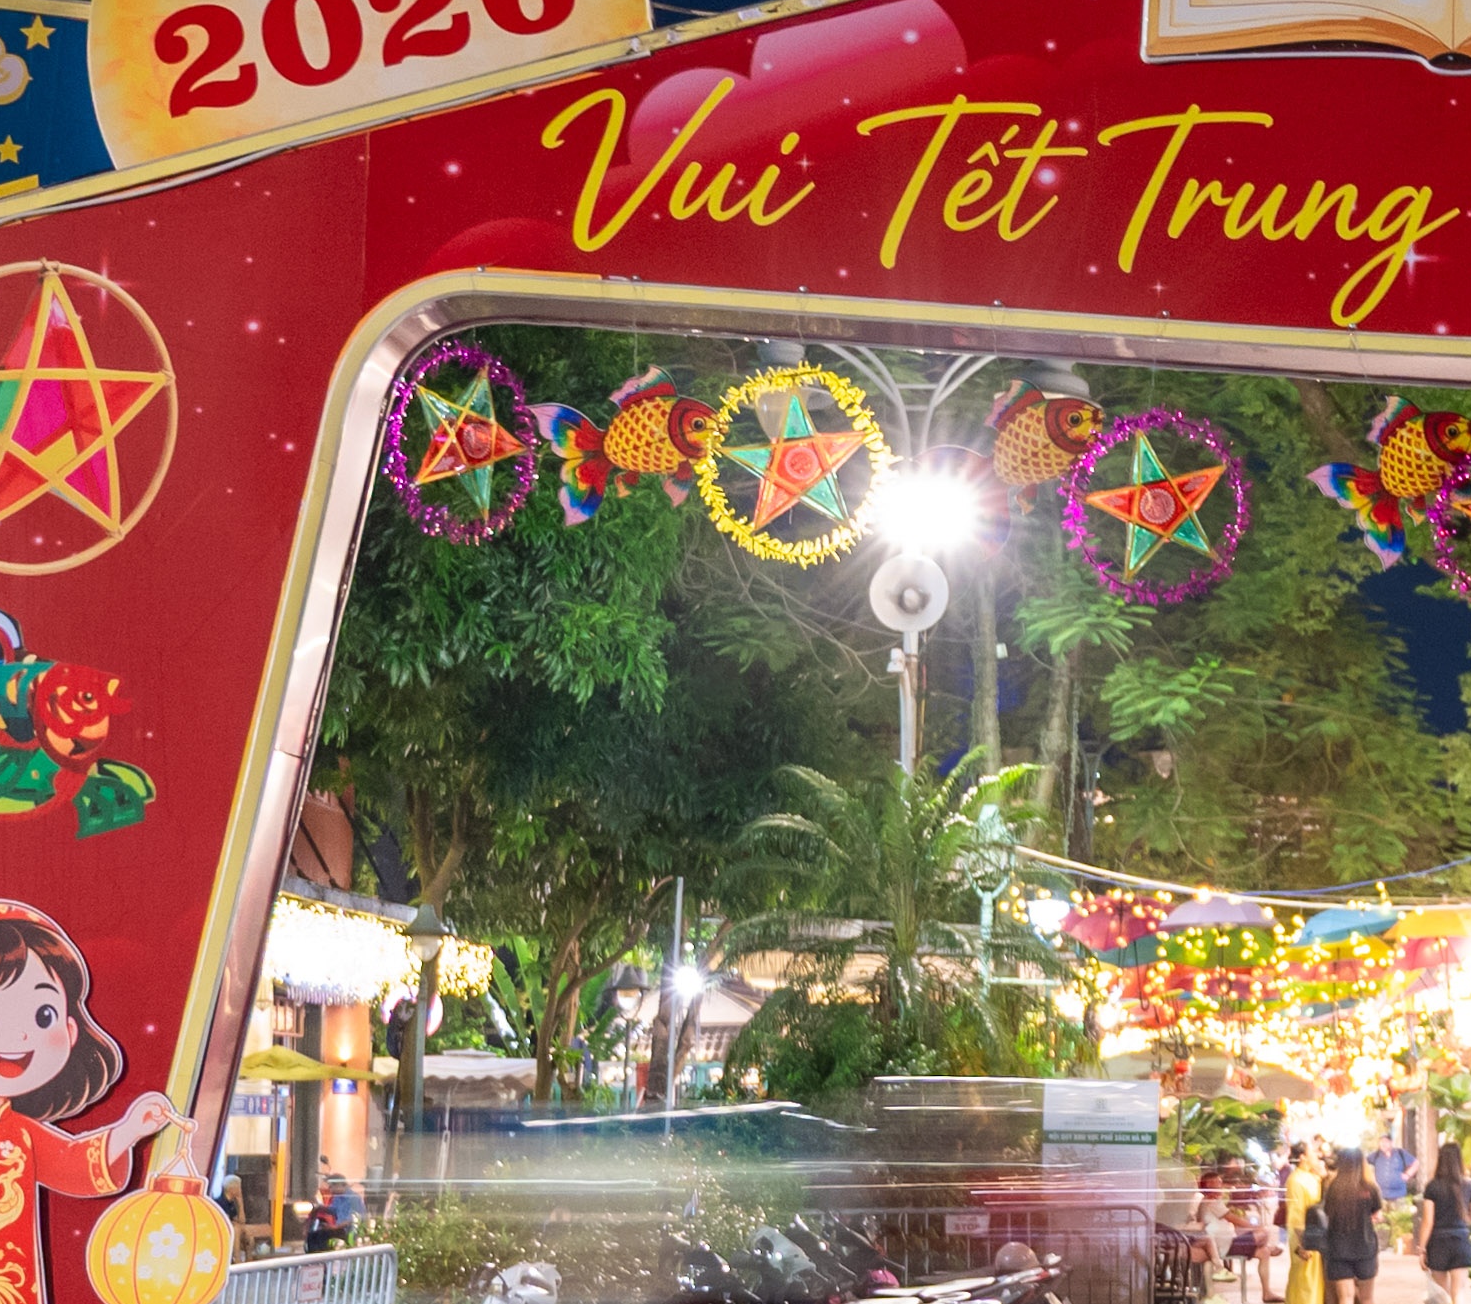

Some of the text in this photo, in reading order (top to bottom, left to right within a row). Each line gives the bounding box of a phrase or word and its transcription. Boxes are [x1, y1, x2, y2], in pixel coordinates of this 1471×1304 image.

[541, 77, 817, 253] Vui
[856, 94, 1089, 270] Tết
[1096, 105, 1460, 327] Trung
